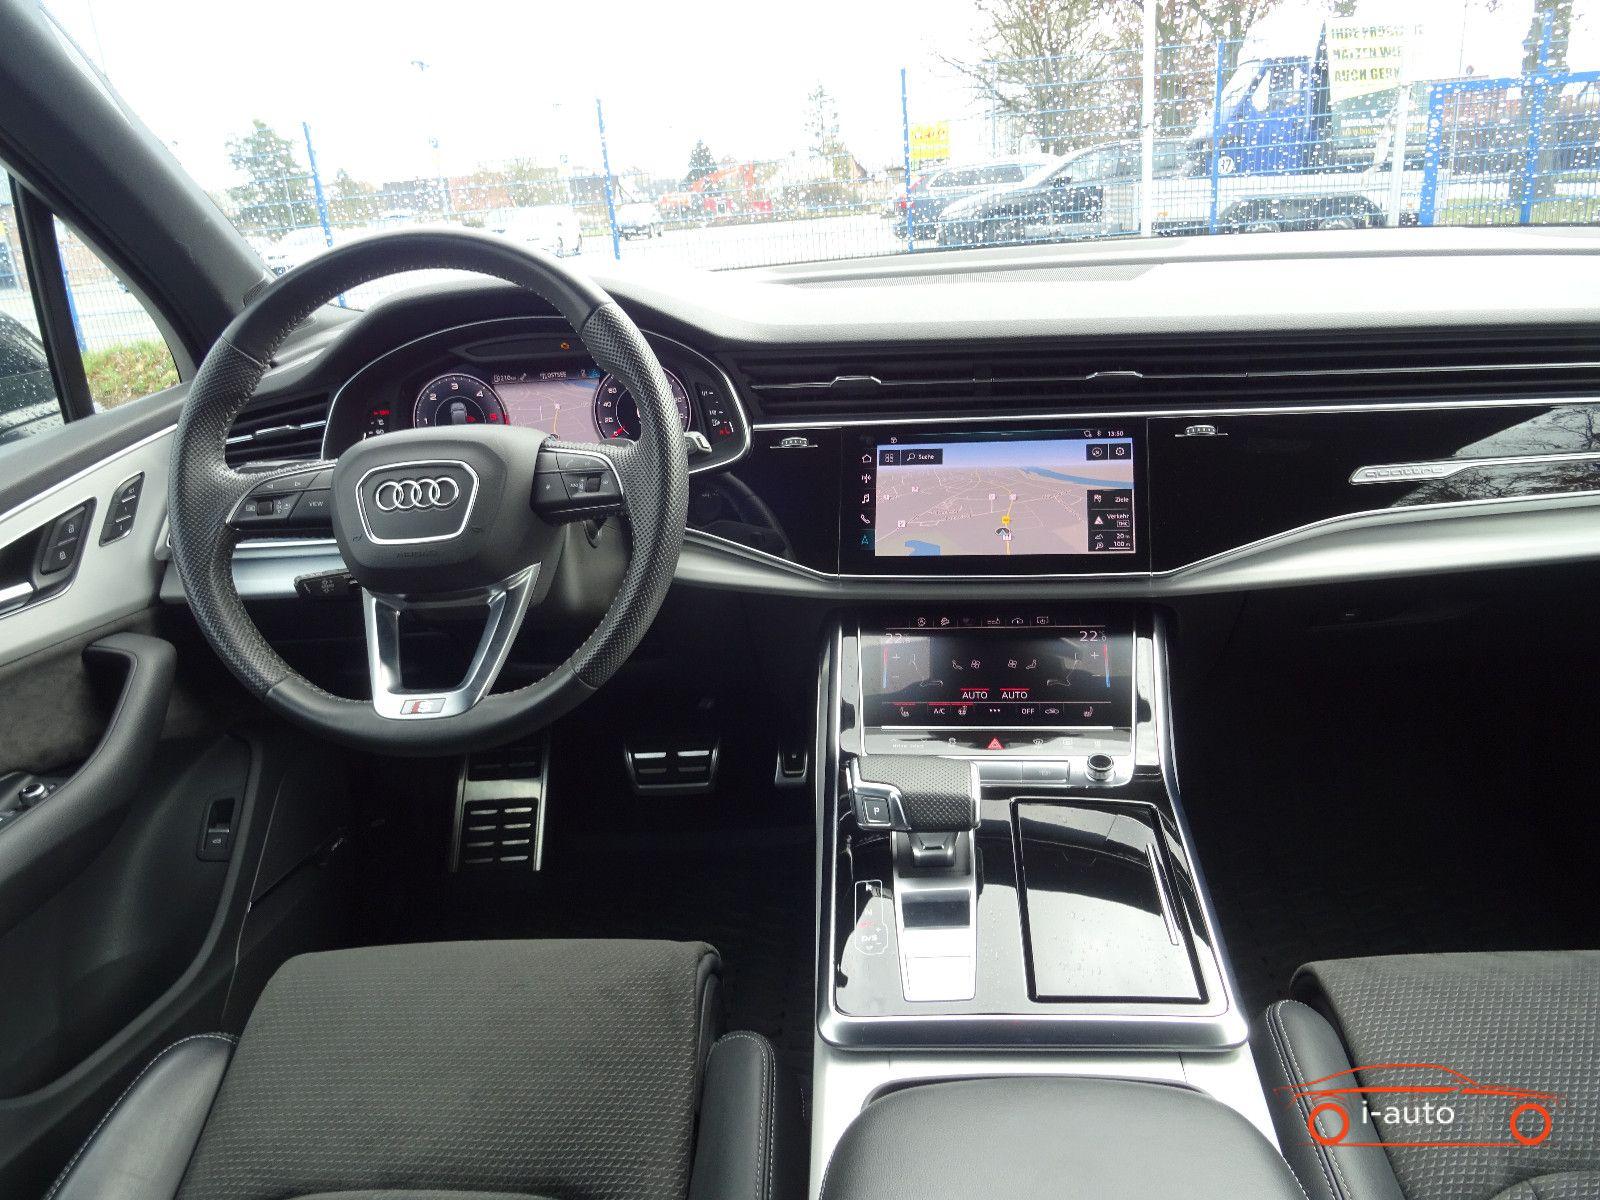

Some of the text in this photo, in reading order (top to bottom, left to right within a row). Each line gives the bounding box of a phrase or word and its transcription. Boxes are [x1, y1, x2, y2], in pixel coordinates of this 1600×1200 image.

[1334, 67, 1367, 82] AUCH
[450, 382, 459, 390] 3
[429, 392, 437, 401] 2
[476, 390, 484, 398] 4
[918, 453, 935, 461] Suche
[962, 691, 1028, 699] AUTO AUTO
[873, 806, 880, 815] P
[865, 883, 872, 891] R
